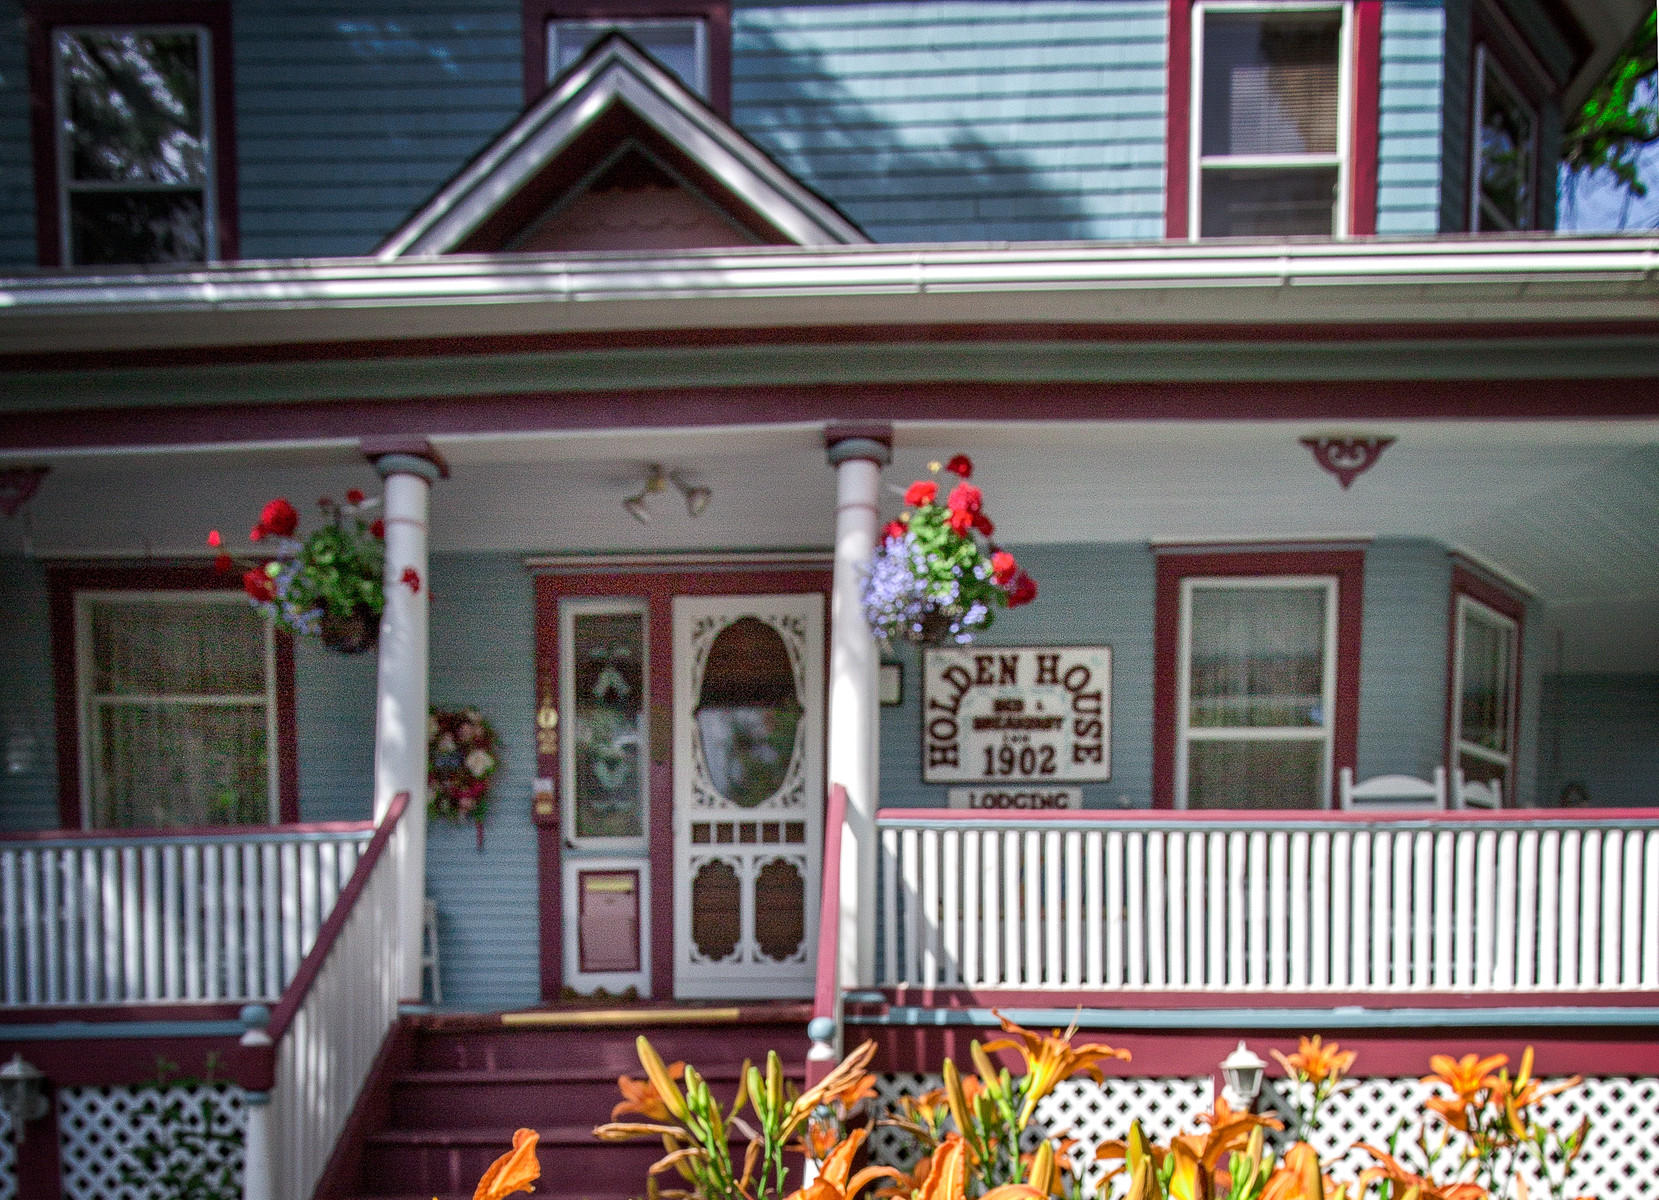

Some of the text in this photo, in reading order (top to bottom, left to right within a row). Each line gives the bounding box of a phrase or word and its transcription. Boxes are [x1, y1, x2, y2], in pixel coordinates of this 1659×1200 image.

[929, 654, 1103, 768] HOLDEN HOUSE
[983, 745, 1056, 776] 1902
[969, 791, 1070, 809] LODGING
